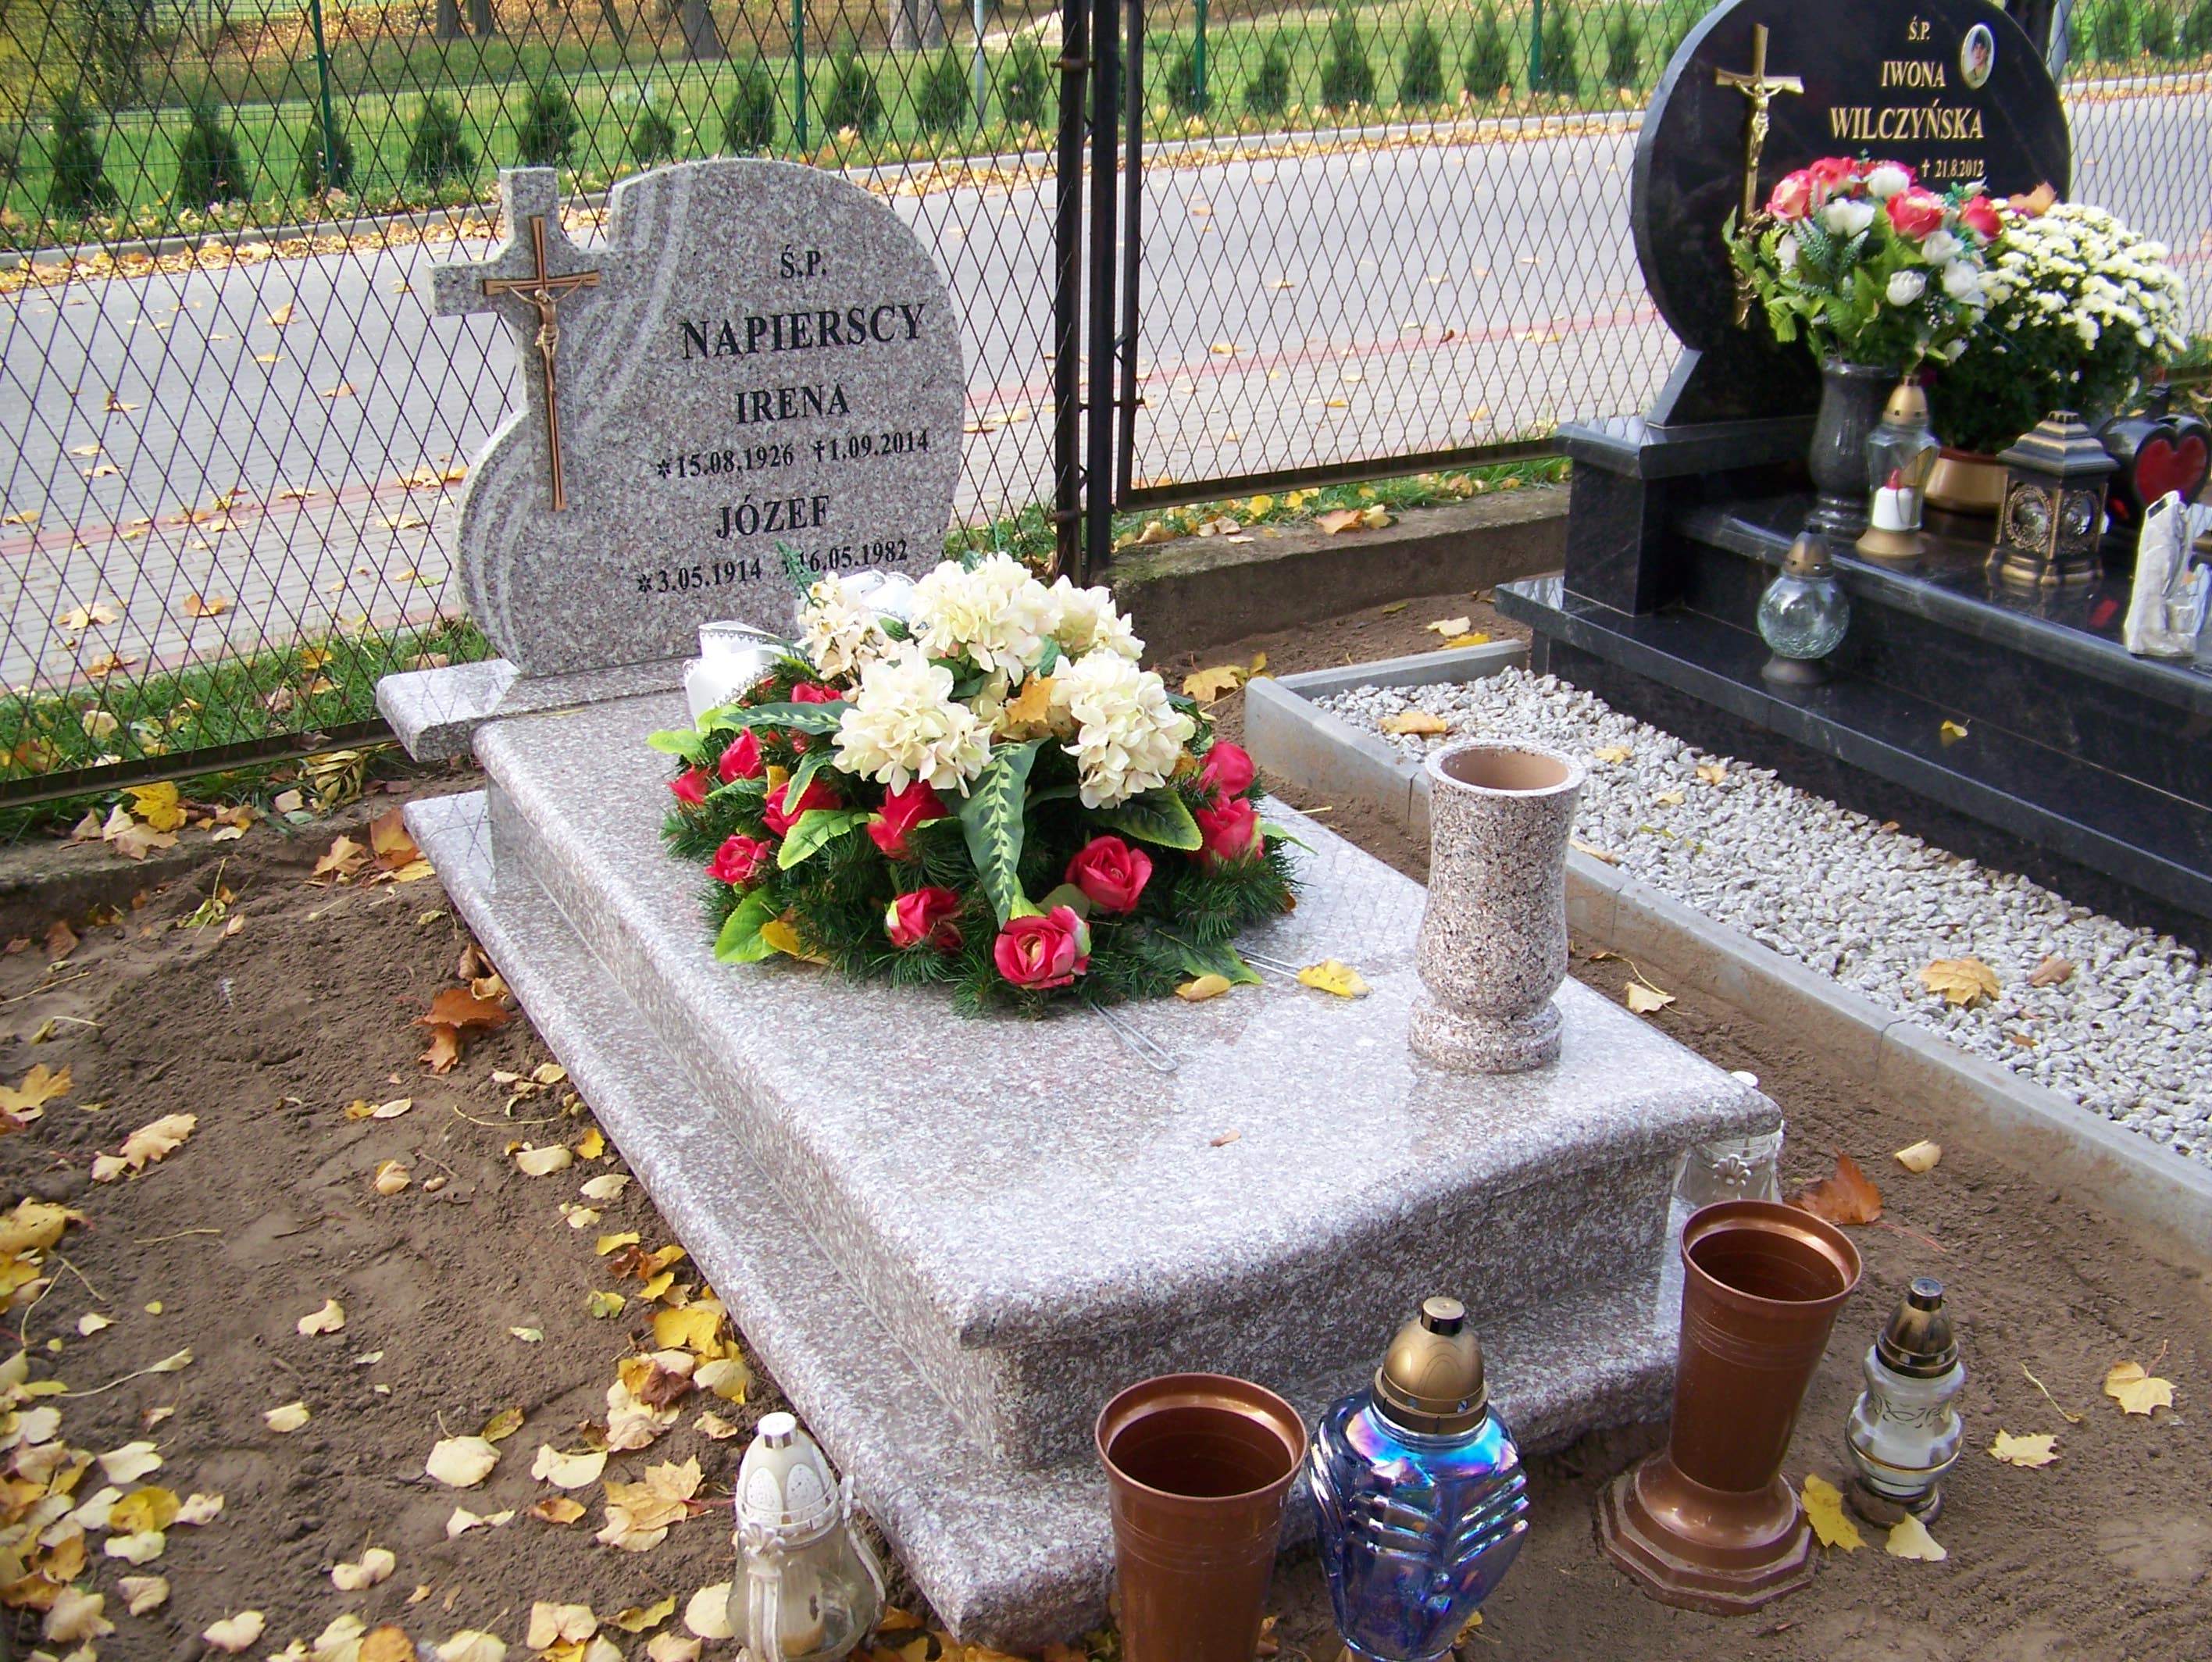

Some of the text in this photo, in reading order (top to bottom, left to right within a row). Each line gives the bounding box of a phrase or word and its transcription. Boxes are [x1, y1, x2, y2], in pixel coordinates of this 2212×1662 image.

[1881, 60, 1946, 88] IWONA
[1830, 98, 1985, 141] WILCZYŃSKA
[1934, 159, 1985, 178] 21.8.2012
[781, 244, 826, 279] Ś.P.
[679, 303, 925, 359] NAPIERSCY
[736, 383, 850, 424] IRENA
[676, 443, 794, 479] 15.08.1926
[716, 494, 830, 539] JÓZEF
[657, 557, 761, 594] 3.05.1914
